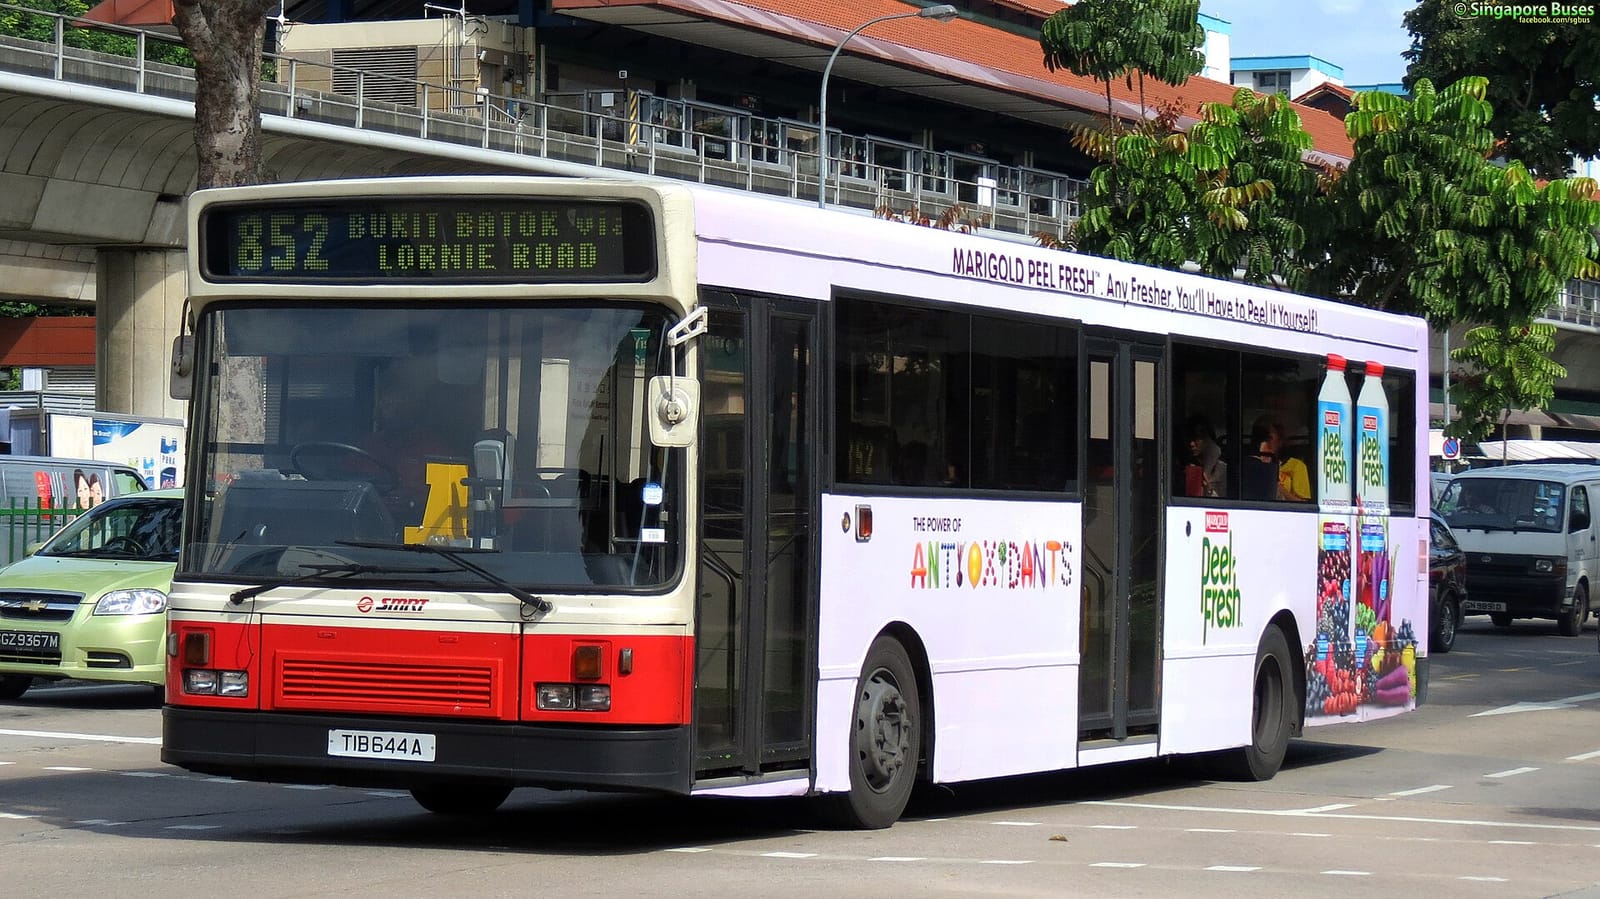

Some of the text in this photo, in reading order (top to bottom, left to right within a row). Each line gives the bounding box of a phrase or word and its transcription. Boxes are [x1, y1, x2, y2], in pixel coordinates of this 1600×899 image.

[348, 212, 439, 239] BUKIT
[456, 211, 560, 238] BATOK
[236, 213, 330, 272] 852
[379, 242, 599, 271] LORNIE ROAD
[952, 247, 1024, 284] MARIGOLD
[1028, 259, 1056, 289] PEEL
[1106, 273, 1129, 307] Any
[1207, 291, 1234, 318] Have
[1235, 297, 1246, 320] to
[1247, 299, 1268, 325] Peel
[1269, 302, 1277, 325] It
[1278, 304, 1318, 331] Yourself!
[913, 517, 962, 532] THE POWER OF
[375, 597, 430, 612] SMRT
[1203, 572, 1241, 646] Fresh
[0, 632, 58, 648] GZ9367M
[342, 734, 423, 756] TIB644A
